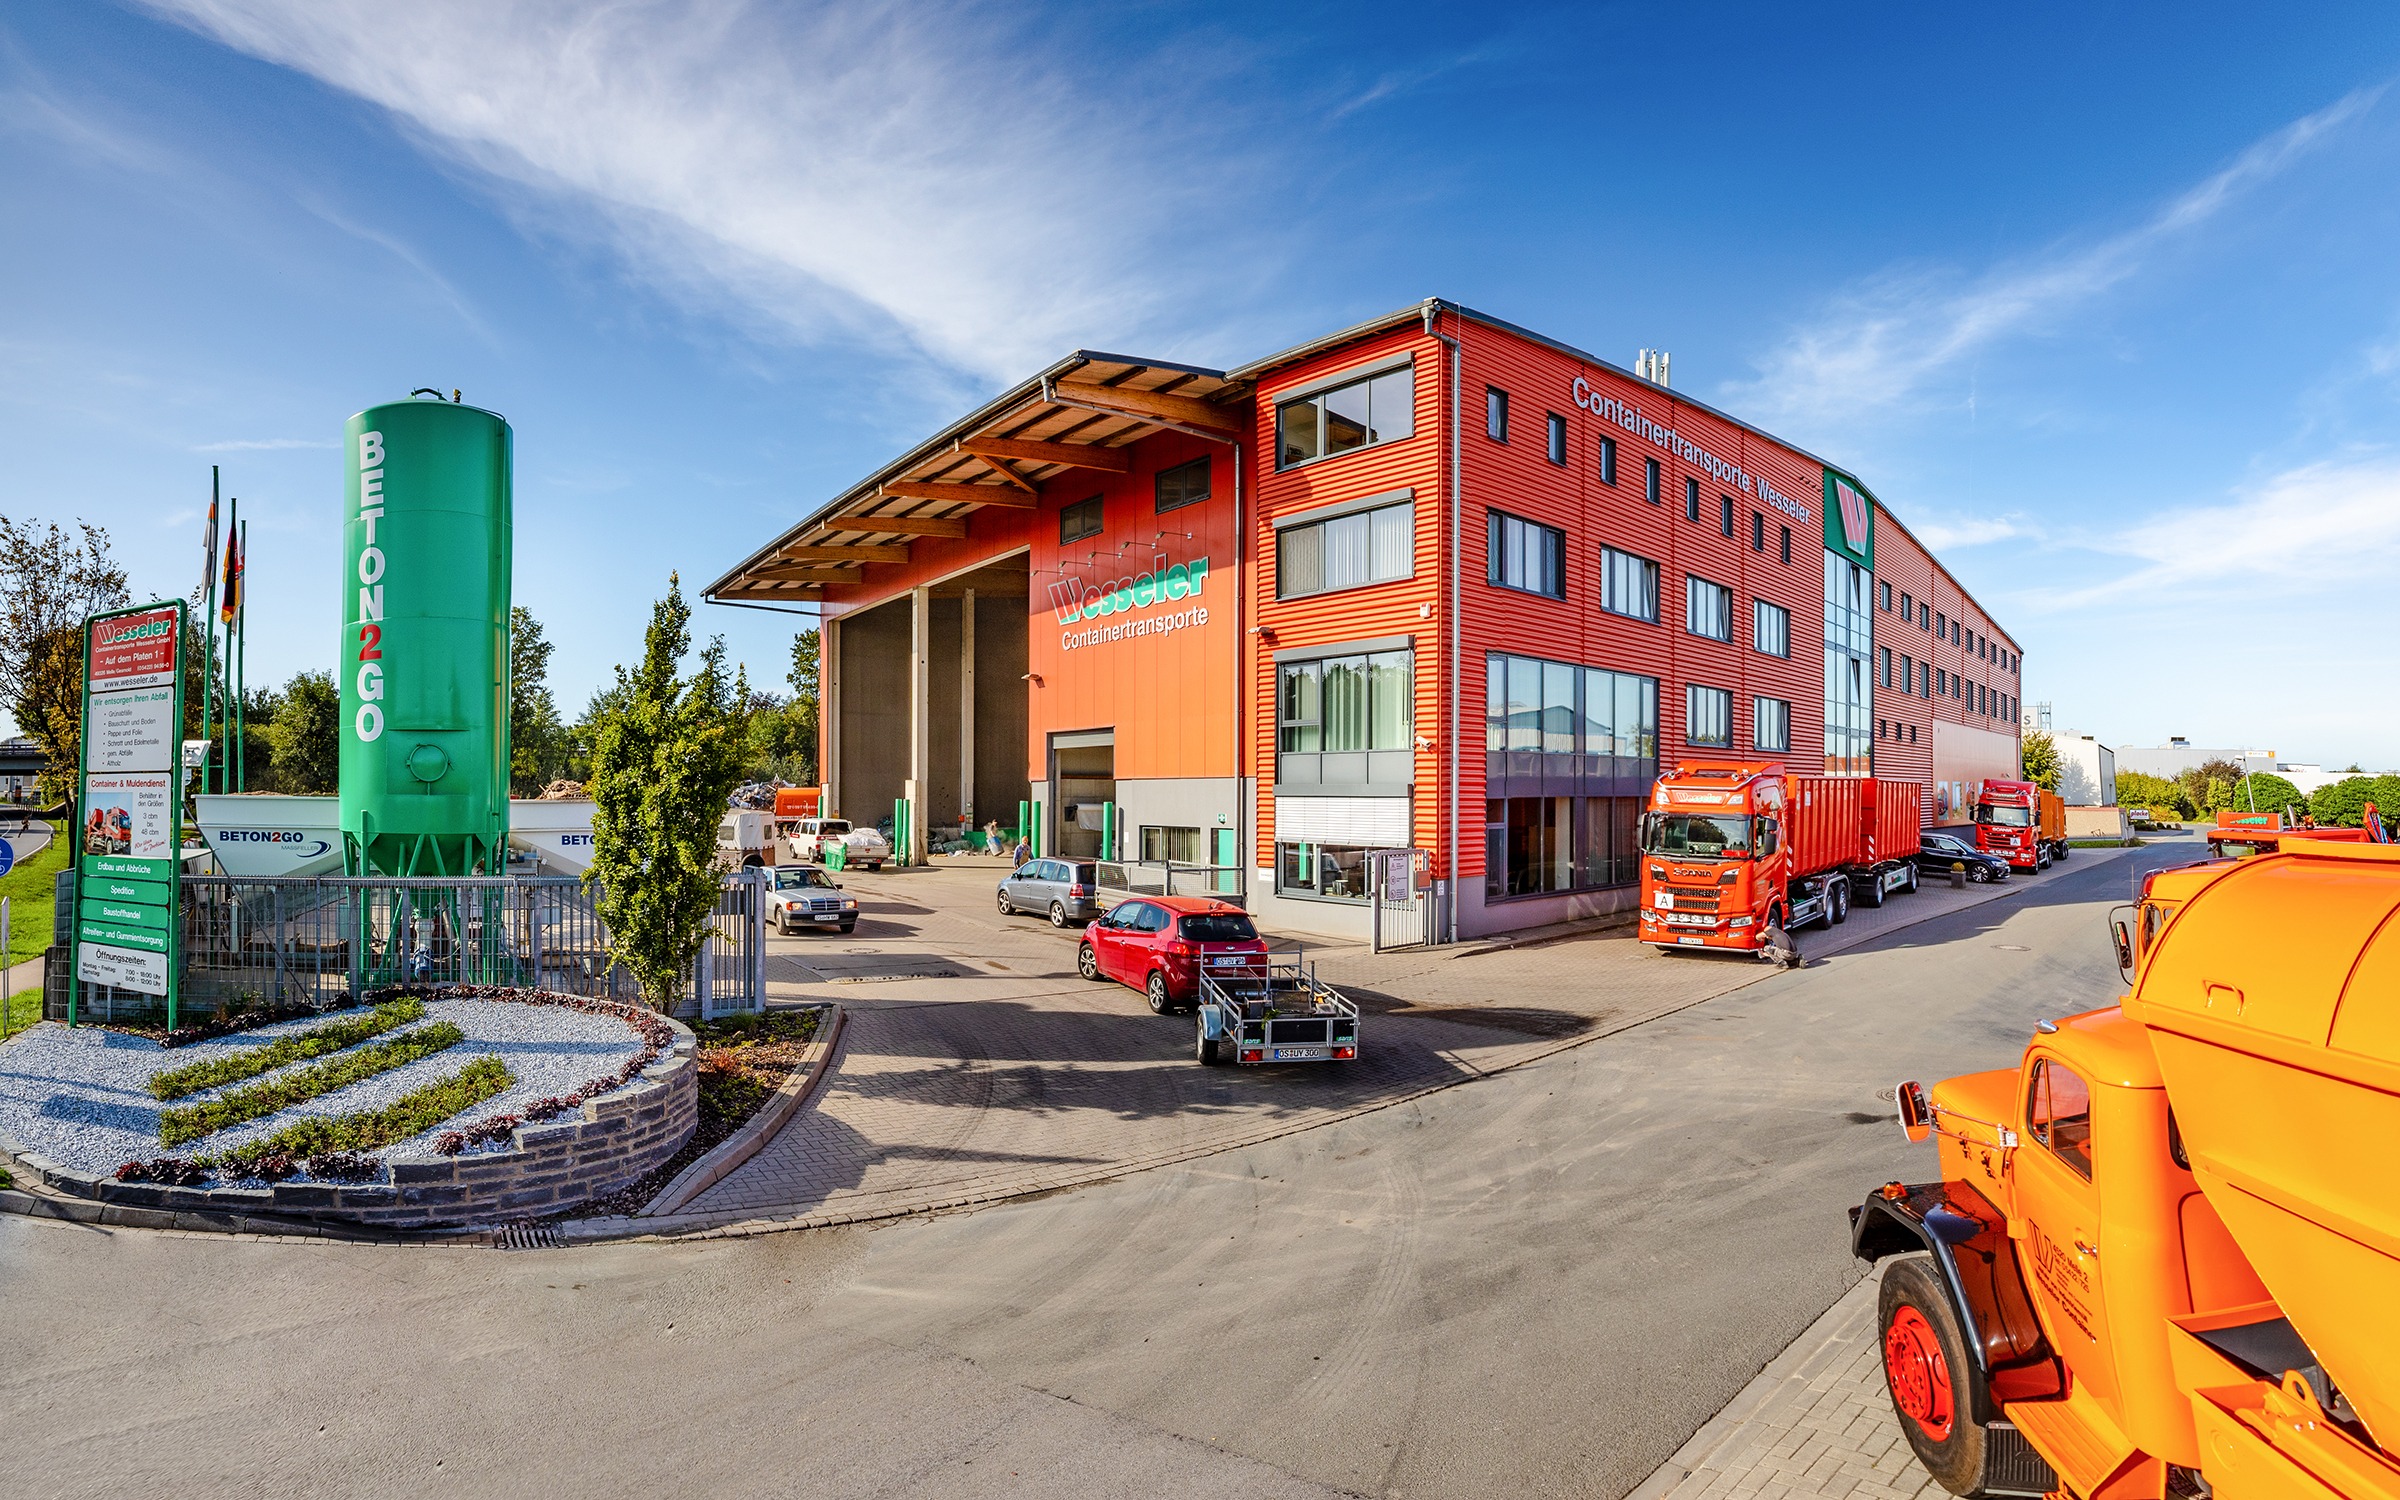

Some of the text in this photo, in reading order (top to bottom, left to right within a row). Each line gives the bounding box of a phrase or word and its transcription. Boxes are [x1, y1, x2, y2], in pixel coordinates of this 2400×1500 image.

[1572, 377, 1811, 525] Containertransporte Wesseler
[355, 430, 386, 743] BETON2GO
[1047, 552, 1210, 626] Wesseler
[97, 617, 171, 645] Wesseler
[1061, 605, 1210, 651] Containertransporte
[95, 642, 135, 653] Containertransporte
[105, 656, 116, 665] Auf
[118, 655, 131, 663] dem
[133, 652, 152, 662] Platen
[154, 650, 158, 658] 1
[104, 674, 158, 688] www.wesseler.de
[104, 696, 132, 705] entsorgen
[151, 692, 168, 701] Abfall
[2024, 715, 2030, 725] S
[1676, 792, 1723, 804] Wesseler
[220, 831, 304, 842] BETON2GO
[97, 862, 114, 870] Erdbau
[126, 864, 151, 874] Abbrüche
[1673, 868, 1712, 877] SCANIA
[110, 885, 135, 895] Spedition
[1660, 896, 1668, 906] A
[103, 907, 140, 919] Baustoffhandel
[83, 927, 104, 936] Altreifen-
[116, 931, 164, 946] Gummientsorgung
[96, 948, 146, 965] Öffnungszeiten:
[1279, 1050, 1289, 1058] OS
[1305, 1048, 1319, 1056] 300
